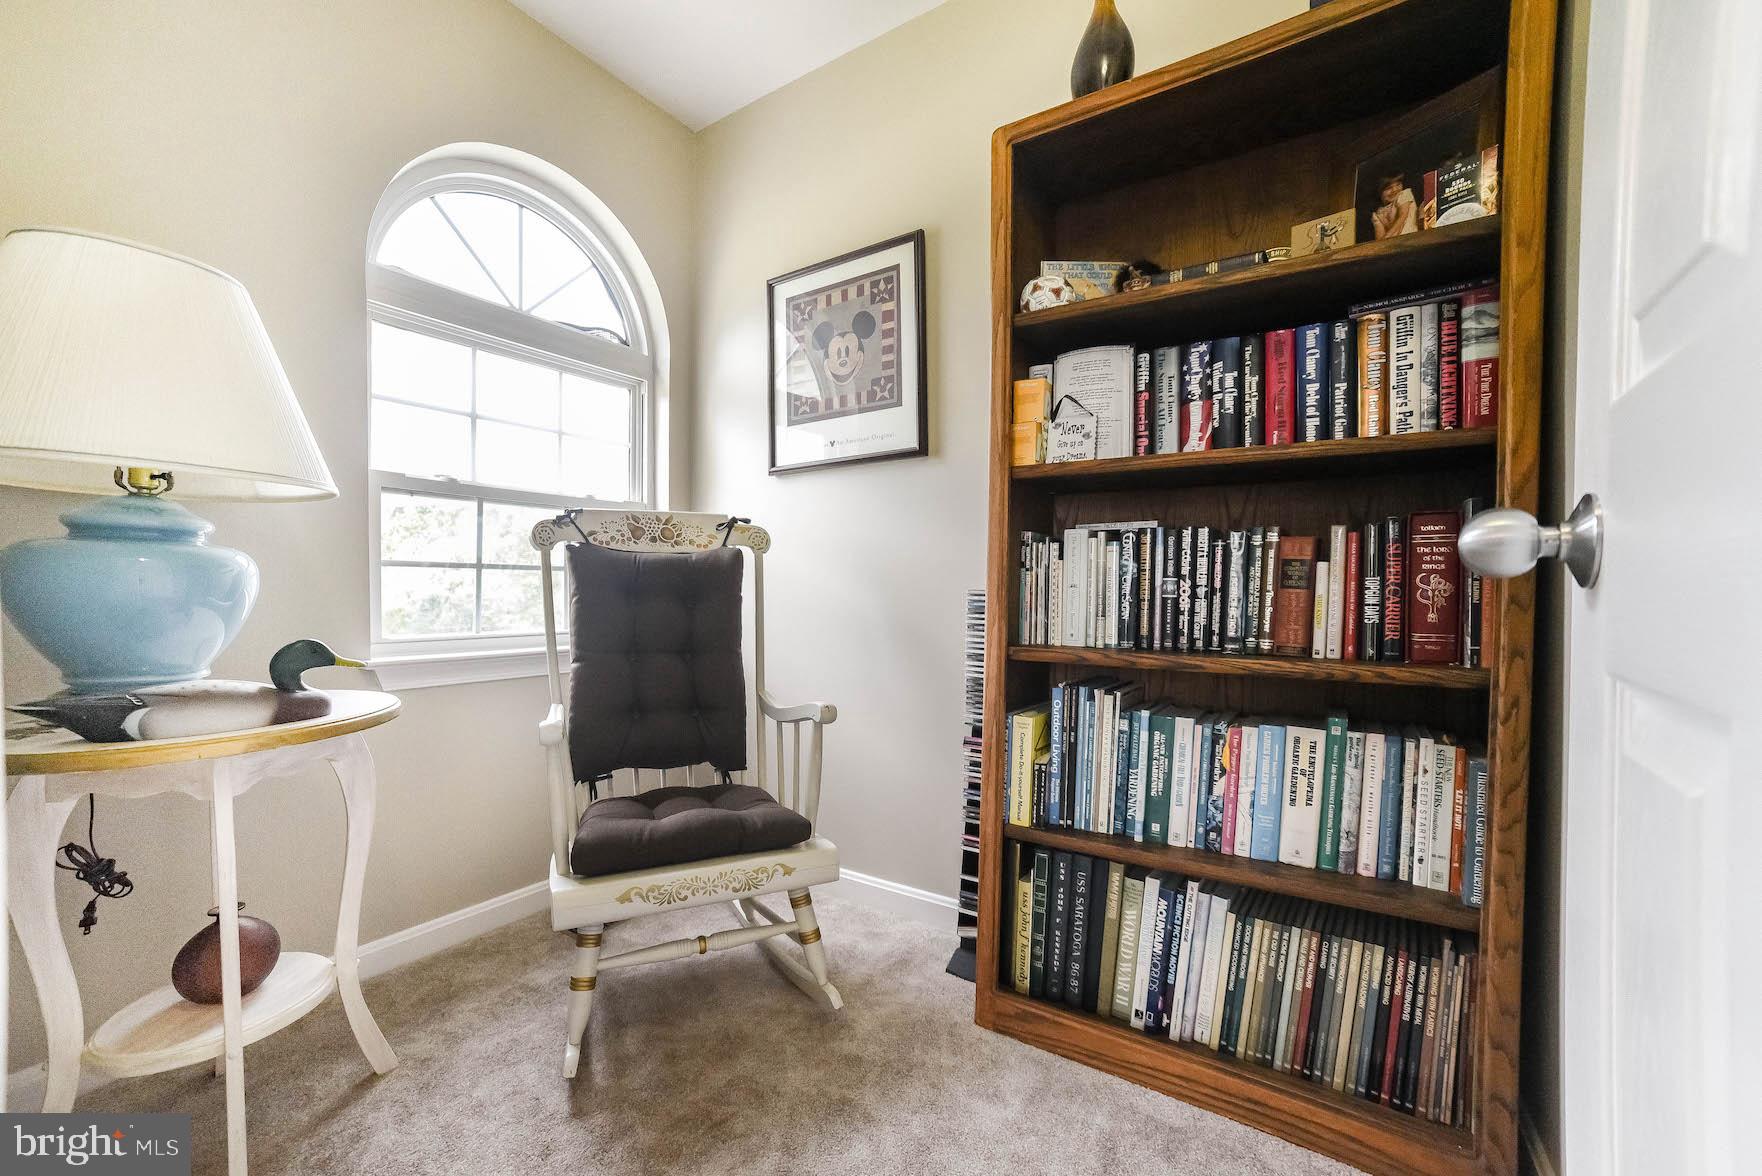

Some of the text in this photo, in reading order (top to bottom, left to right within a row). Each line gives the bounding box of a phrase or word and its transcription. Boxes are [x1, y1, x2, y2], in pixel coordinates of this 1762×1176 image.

[1244, 345, 1252, 361] The
[1368, 321, 1386, 347] Tom
[1244, 362, 1252, 392] Cardinal
[1302, 327, 1320, 442] Tom Clancy Debt of Hono
[1363, 352, 1386, 391] Clancy
[1392, 314, 1414, 434] Griffin In Danger's Path
[1440, 356, 1457, 426] LIGHTNING
[1480, 363, 1492, 415] THE FIRE DREAM
[1137, 353, 1150, 435] Griffin Special
[1158, 396, 1165, 404] of
[1166, 395, 1175, 424] Clancy
[1212, 361, 1224, 428] Without Remorse
[1221, 371, 1238, 414] Tom Clancy
[1244, 402, 1252, 415] the
[1250, 375, 1259, 417] Tom Clancy
[1334, 382, 1347, 440] Patriot Gam
[1368, 395, 1379, 412] Red
[1057, 440, 1068, 448] Give
[1060, 421, 1084, 436] Never
[1157, 424, 1165, 450] Fears
[1227, 578, 1238, 634] SCIENCE FICTION
[1263, 591, 1274, 632] Tom Sawyer
[1364, 576, 1380, 624] TOPGUN DAYS
[1051, 699, 1061, 773] Outdoor Living
[1150, 760, 1158, 797] GARDENING
[1260, 731, 1271, 805] GARDEN PROBLEM SOLVER
[1289, 736, 1300, 806] ORGANIC GARDENING
[1300, 769, 1306, 777] OF
[1306, 741, 1317, 807] THE ENCYCLOPEDIA
[1127, 768, 1139, 819] YARDENING
[1455, 789, 1463, 803] LET
[1455, 804, 1462, 814] IT
[1418, 781, 1429, 853] SEED STARTER
[1471, 772, 1487, 904] Illustrated Guide to Gardening
[1021, 910, 1030, 931] john
[1069, 872, 1086, 994] USS SARATOGA 86-87
[1184, 904, 1192, 926] CUTTING
[1019, 934, 1030, 942] f
[1116, 909, 1136, 1007] WORLD WAR II
[1168, 894, 1184, 984] SCIENCE FICTION MOVIES
[1229, 921, 1242, 991] ADVANCED WOODWORKING
[1320, 942, 1329, 969] CLEANING
[1018, 943, 1029, 984] kennedy
[1239, 956, 1247, 978] WINDOWS
[1328, 957, 1336, 980] SECURITY
[1358, 951, 1370, 1008] ADVANCED MASONRY
[1382, 956, 1394, 1005] ADVANCED WIRING
[1394, 958, 1404, 995] LANDSCAPING
[1418, 966, 1427, 993] WORKING
[1430, 967, 1439, 995] WORKING
[1402, 960, 1416, 1021] ENERGY ALTERNATIVES
[1415, 1008, 1423, 1025] METAL
[1426, 1011, 1435, 1037] PLASTICS
